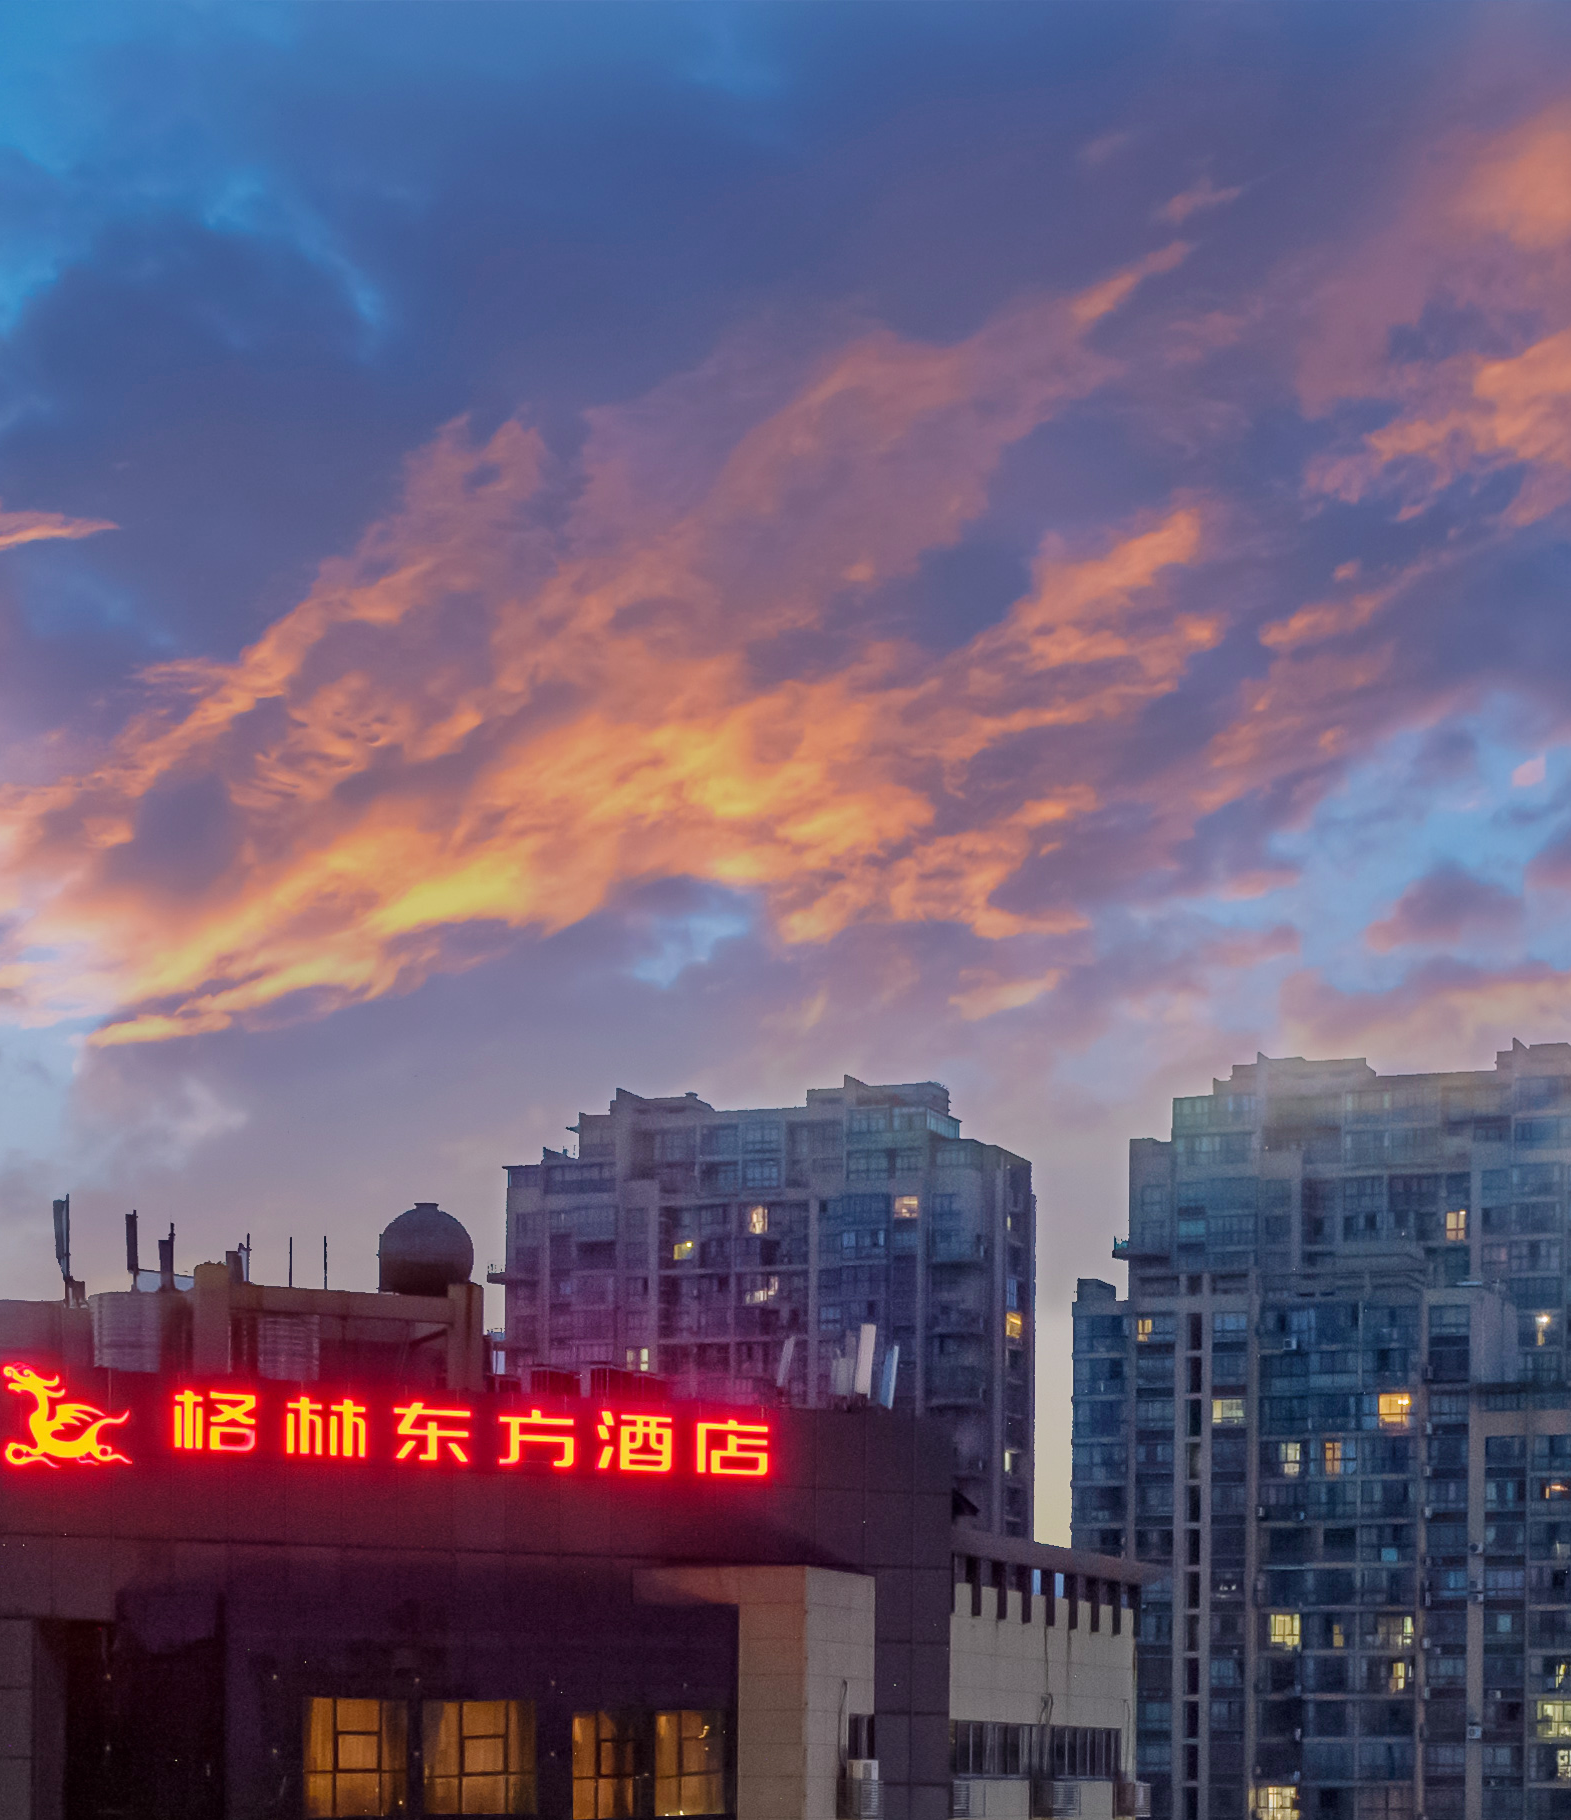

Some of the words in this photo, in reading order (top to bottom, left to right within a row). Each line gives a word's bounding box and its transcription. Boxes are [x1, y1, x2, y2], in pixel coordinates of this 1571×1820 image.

[173, 1388, 771, 1476] 格林东方酒店
